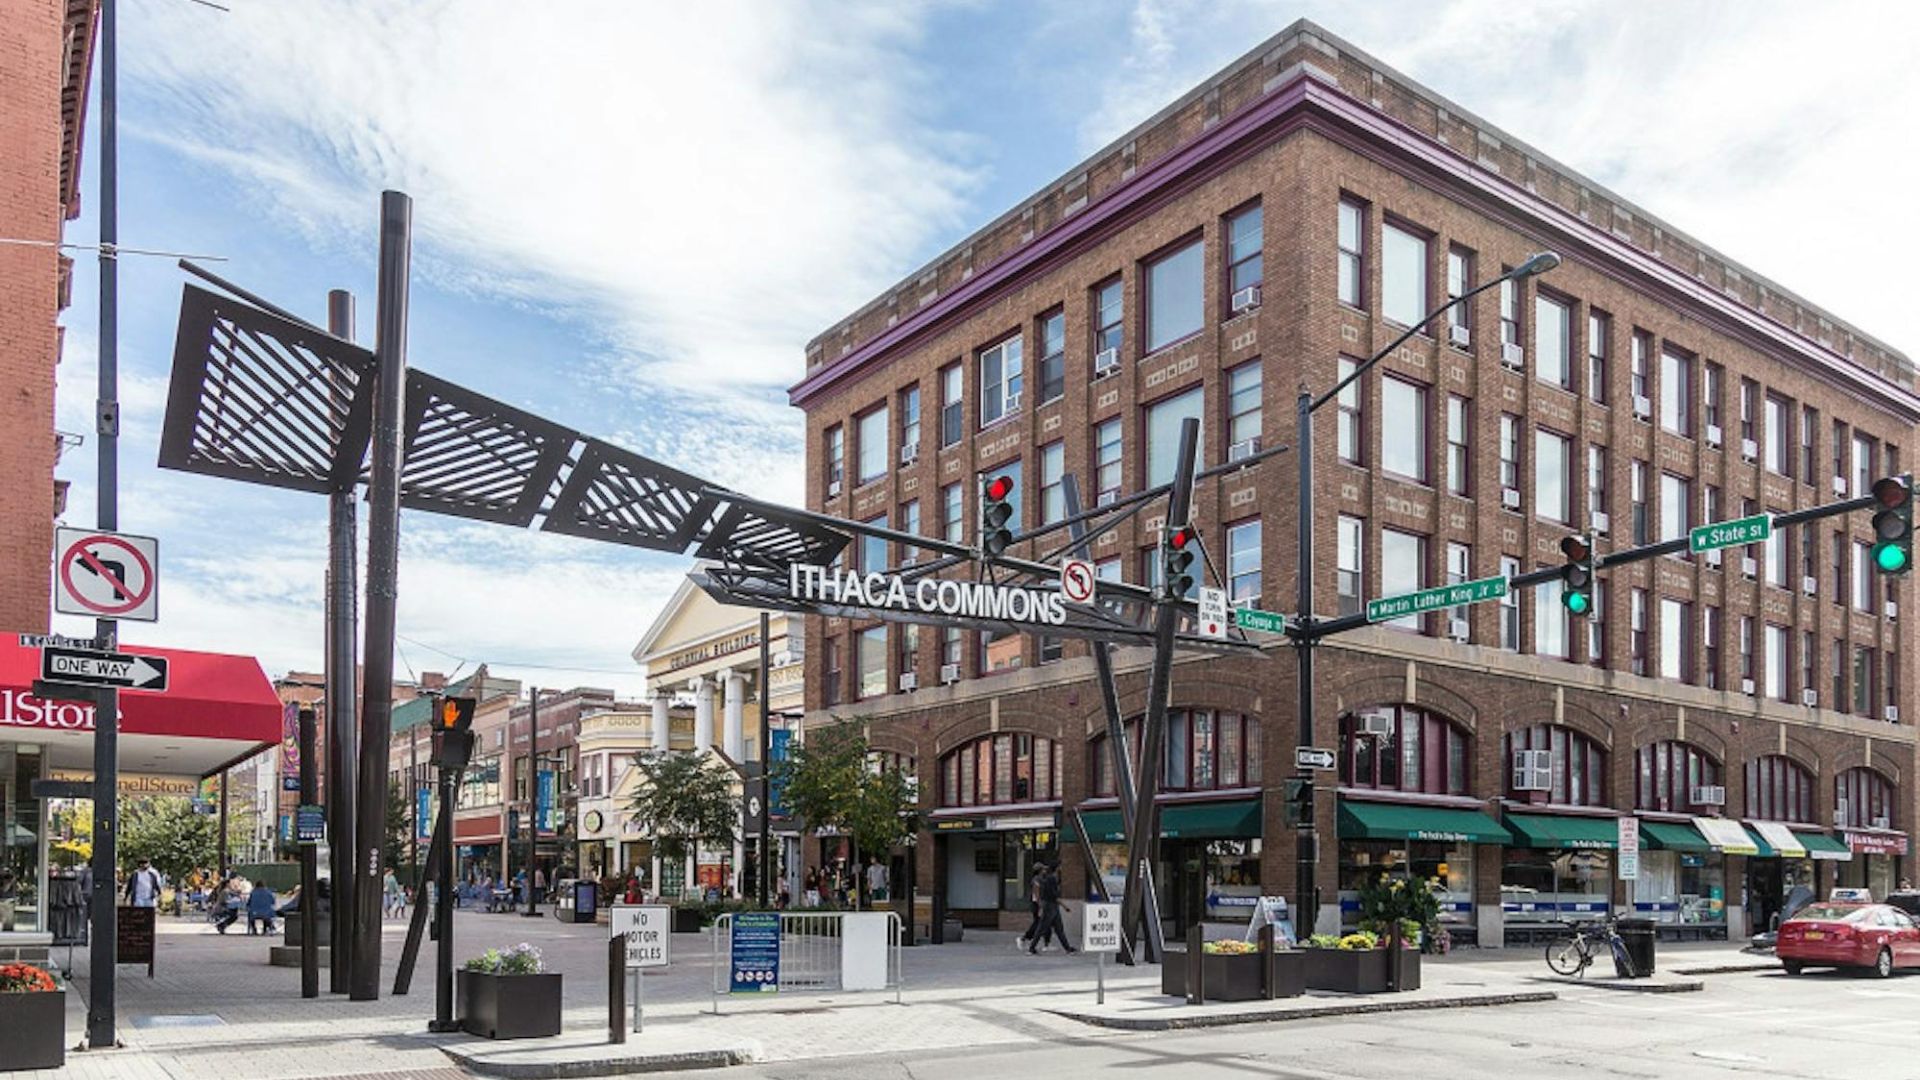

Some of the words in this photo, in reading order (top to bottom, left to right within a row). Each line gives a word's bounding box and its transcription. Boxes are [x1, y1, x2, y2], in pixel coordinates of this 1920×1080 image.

[1710, 526, 1746, 544] State
[790, 563, 909, 610] ITHACA
[916, 579, 1067, 625] COMMONS
[1207, 590, 1219, 601] NO
[1380, 600, 1410, 614] Martin
[1414, 593, 1446, 609] Luther
[1450, 588, 1473, 602] King
[1205, 603, 1222, 612] TURN
[1245, 612, 1272, 630] Cayuga
[671, 647, 709, 668] COLONIAL
[713, 632, 757, 655] BUILDING
[56, 657, 91, 673] ONE
[96, 662, 130, 677] WAY
[632, 911, 648, 926] NO
[1098, 909, 1108, 919] NO
[1091, 922, 1114, 932] MOTOR
[1089, 936, 1116, 946] VEHICLES
